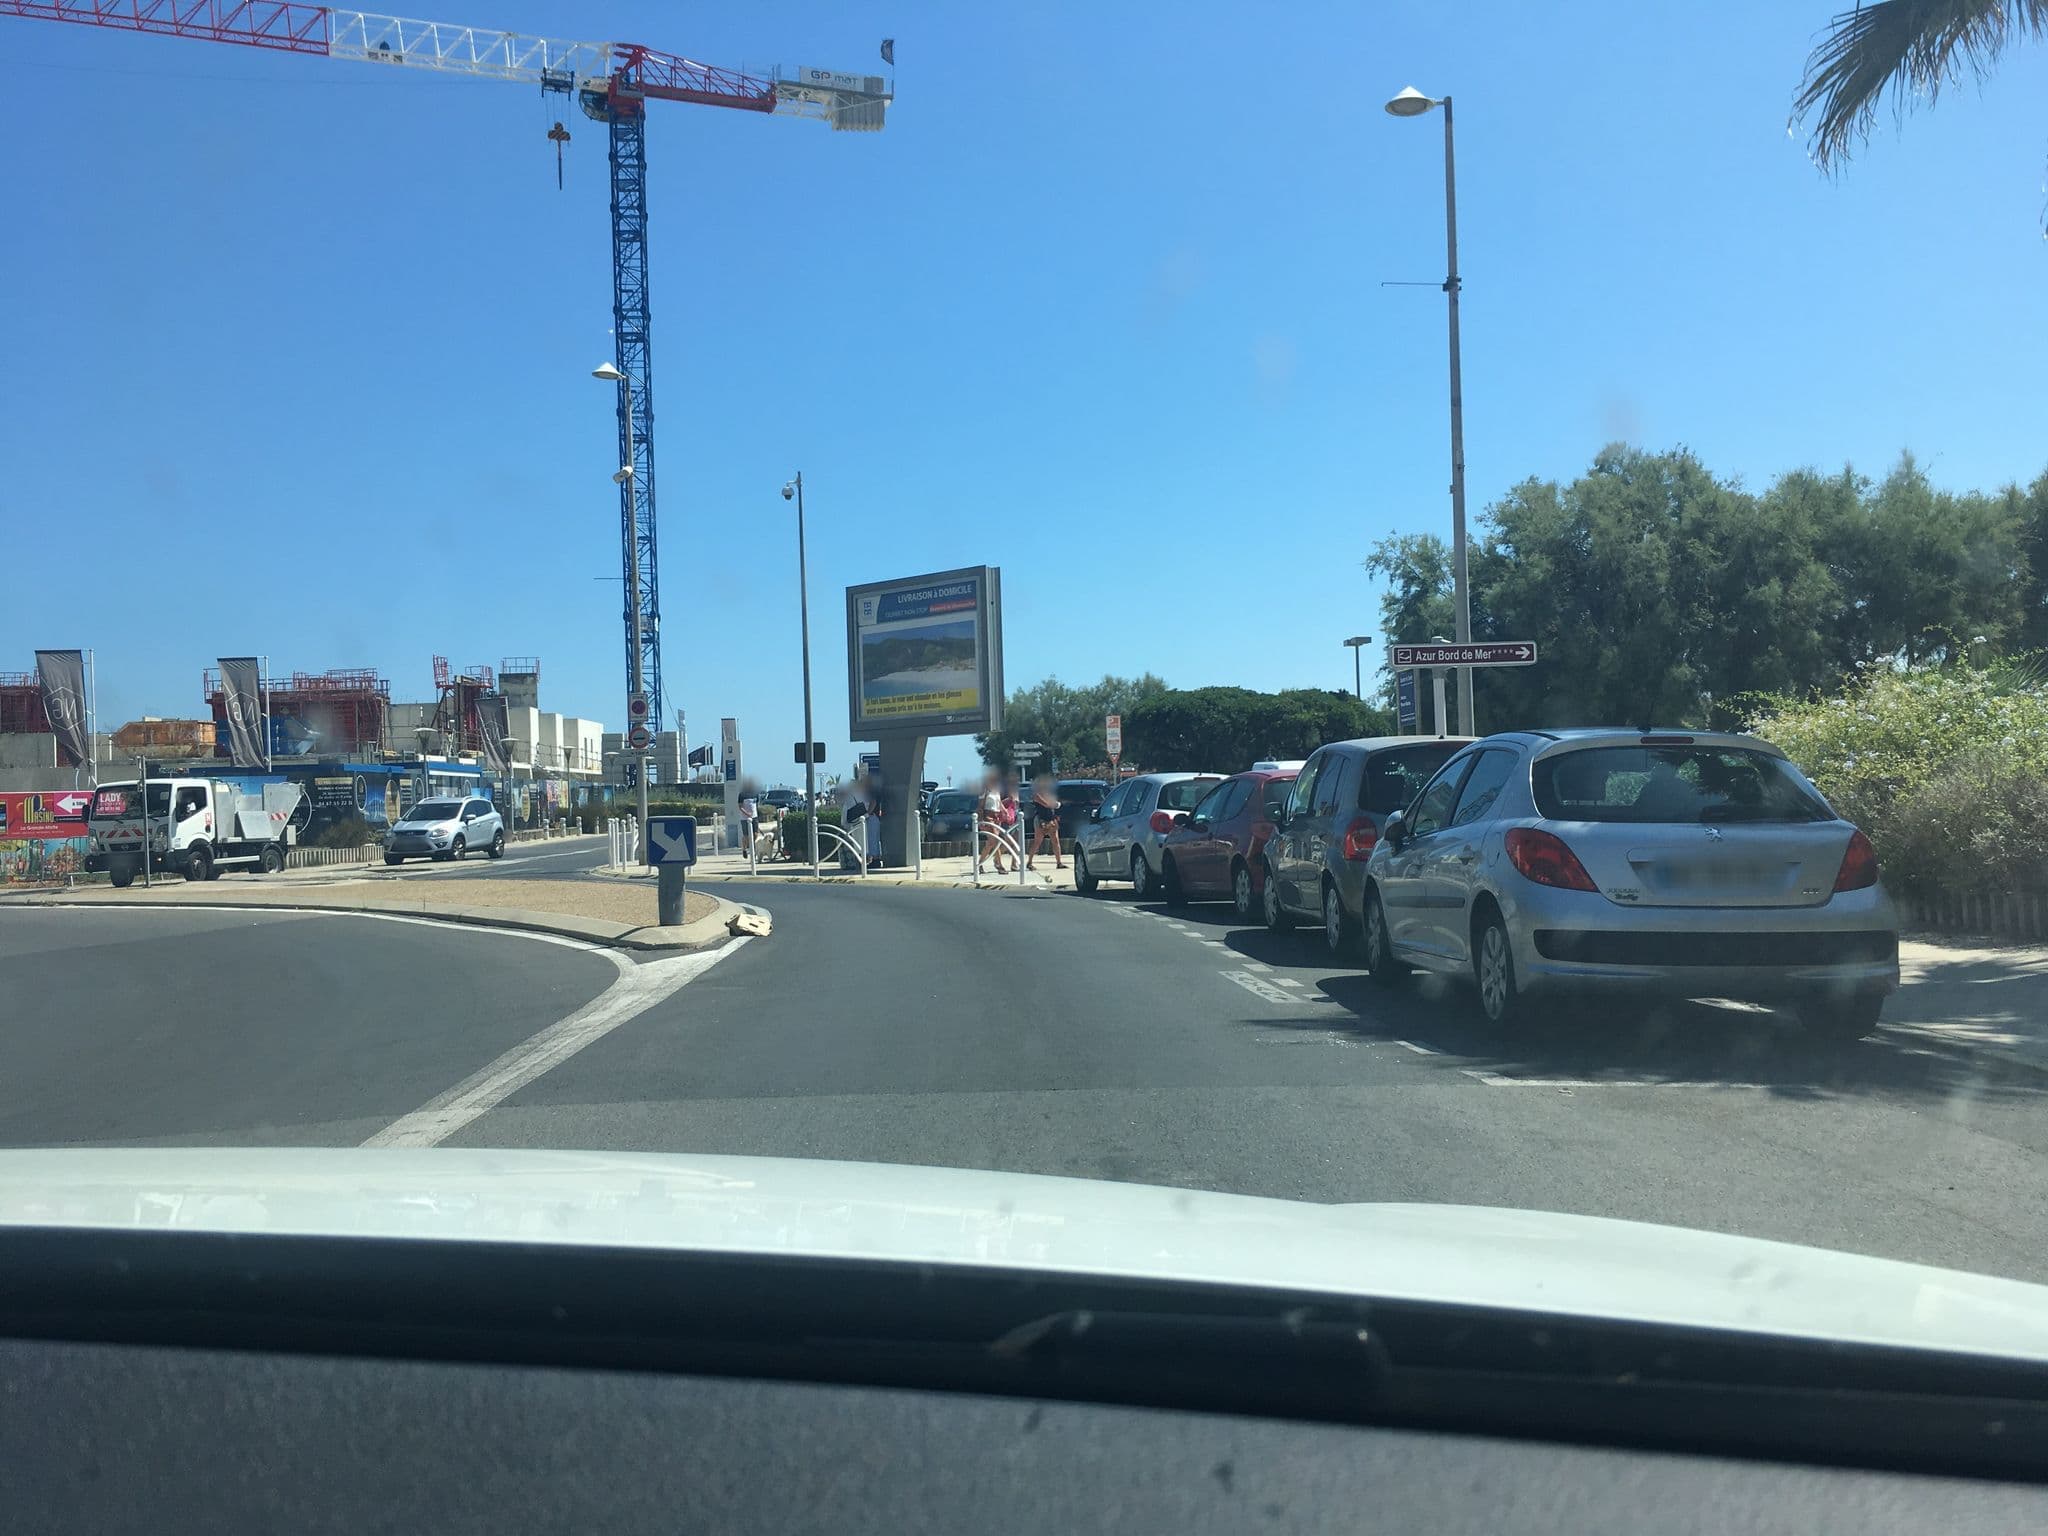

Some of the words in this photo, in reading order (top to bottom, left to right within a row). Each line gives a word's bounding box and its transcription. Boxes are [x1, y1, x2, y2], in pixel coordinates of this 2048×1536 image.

[810, 70, 831, 80] GP
[897, 590, 934, 604] LIVRAISON
[938, 584, 972, 598] DOMICILE
[1416, 651, 1436, 662] Azur
[1438, 650, 1460, 661] Bord
[1461, 649, 1473, 660] de
[1475, 649, 1492, 660] Mer
[100, 793, 121, 803] LADY
